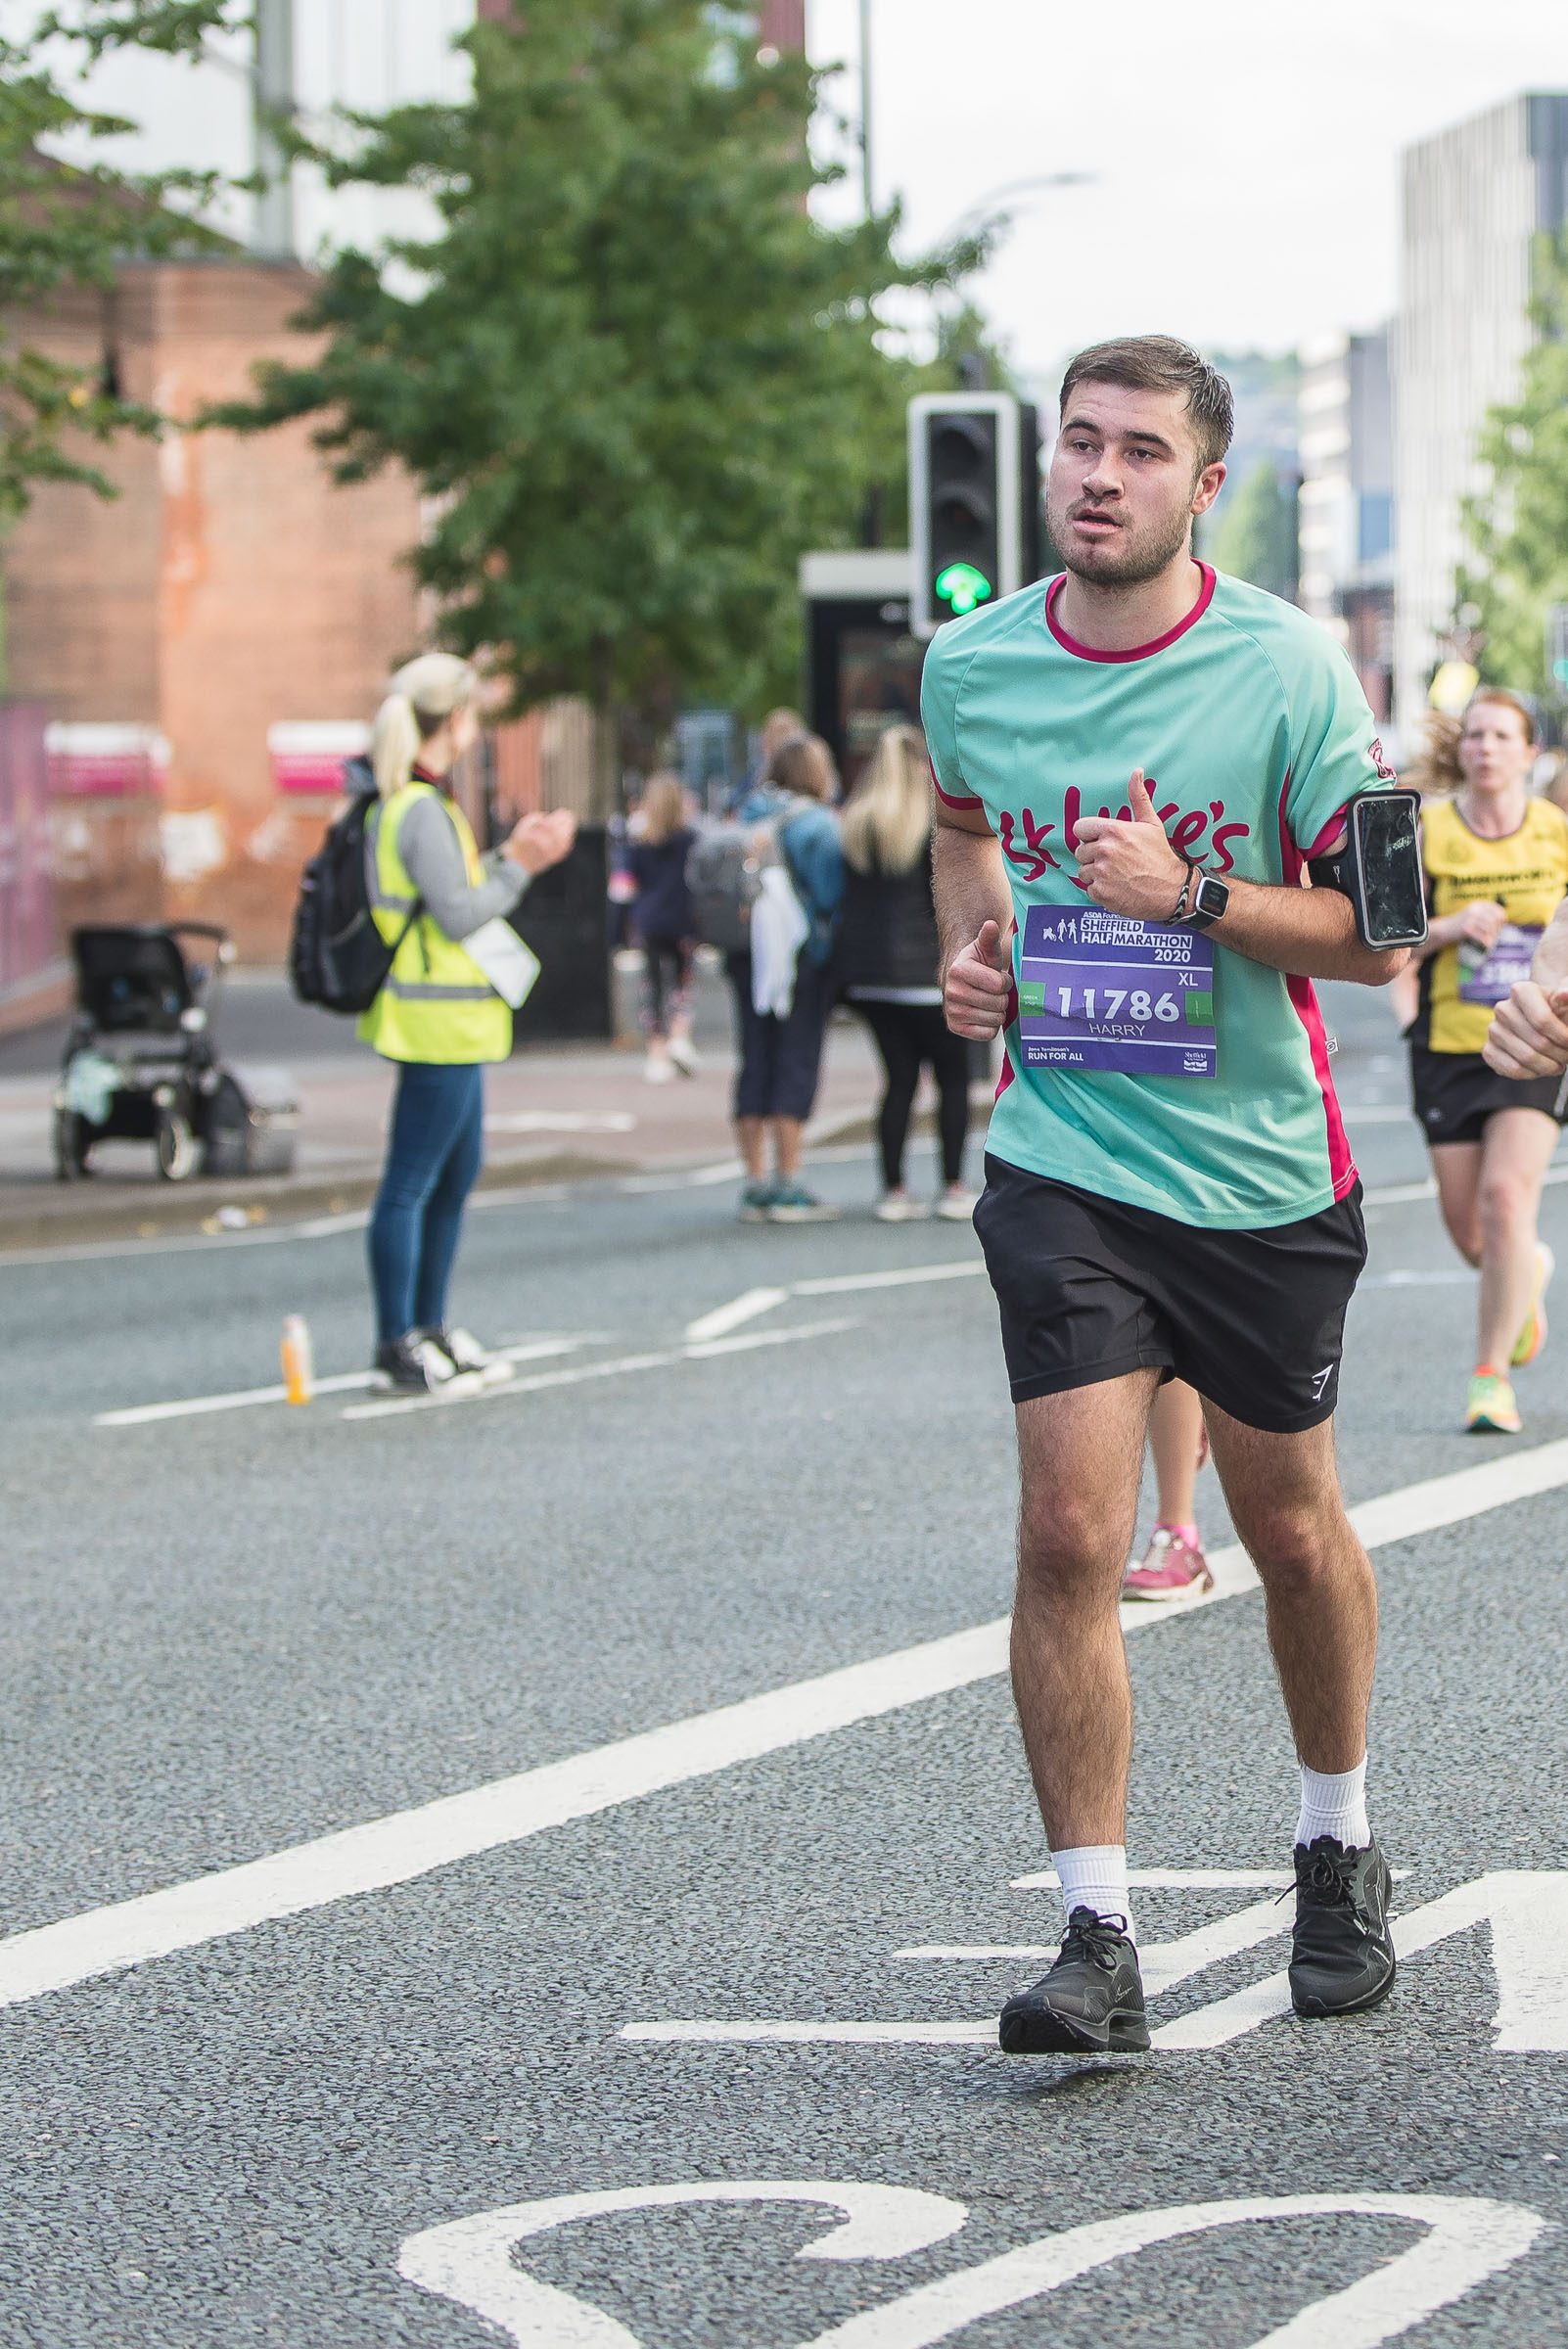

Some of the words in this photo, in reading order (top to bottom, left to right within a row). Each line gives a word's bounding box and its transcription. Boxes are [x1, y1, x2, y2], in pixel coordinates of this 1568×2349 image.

[1082, 919, 1142, 933] SHEFFIELD
[1081, 932, 1113, 944] HALF
[1114, 933, 1192, 948] MARATHON
[1154, 948, 1191, 963] 2020
[1177, 972, 1199, 987] XL
[1058, 987, 1180, 1023] 11786
[1088, 1023, 1146, 1037] HARRY
[1048, 1052, 1067, 1061] FOR
[1068, 1052, 1084, 1062] ALL
